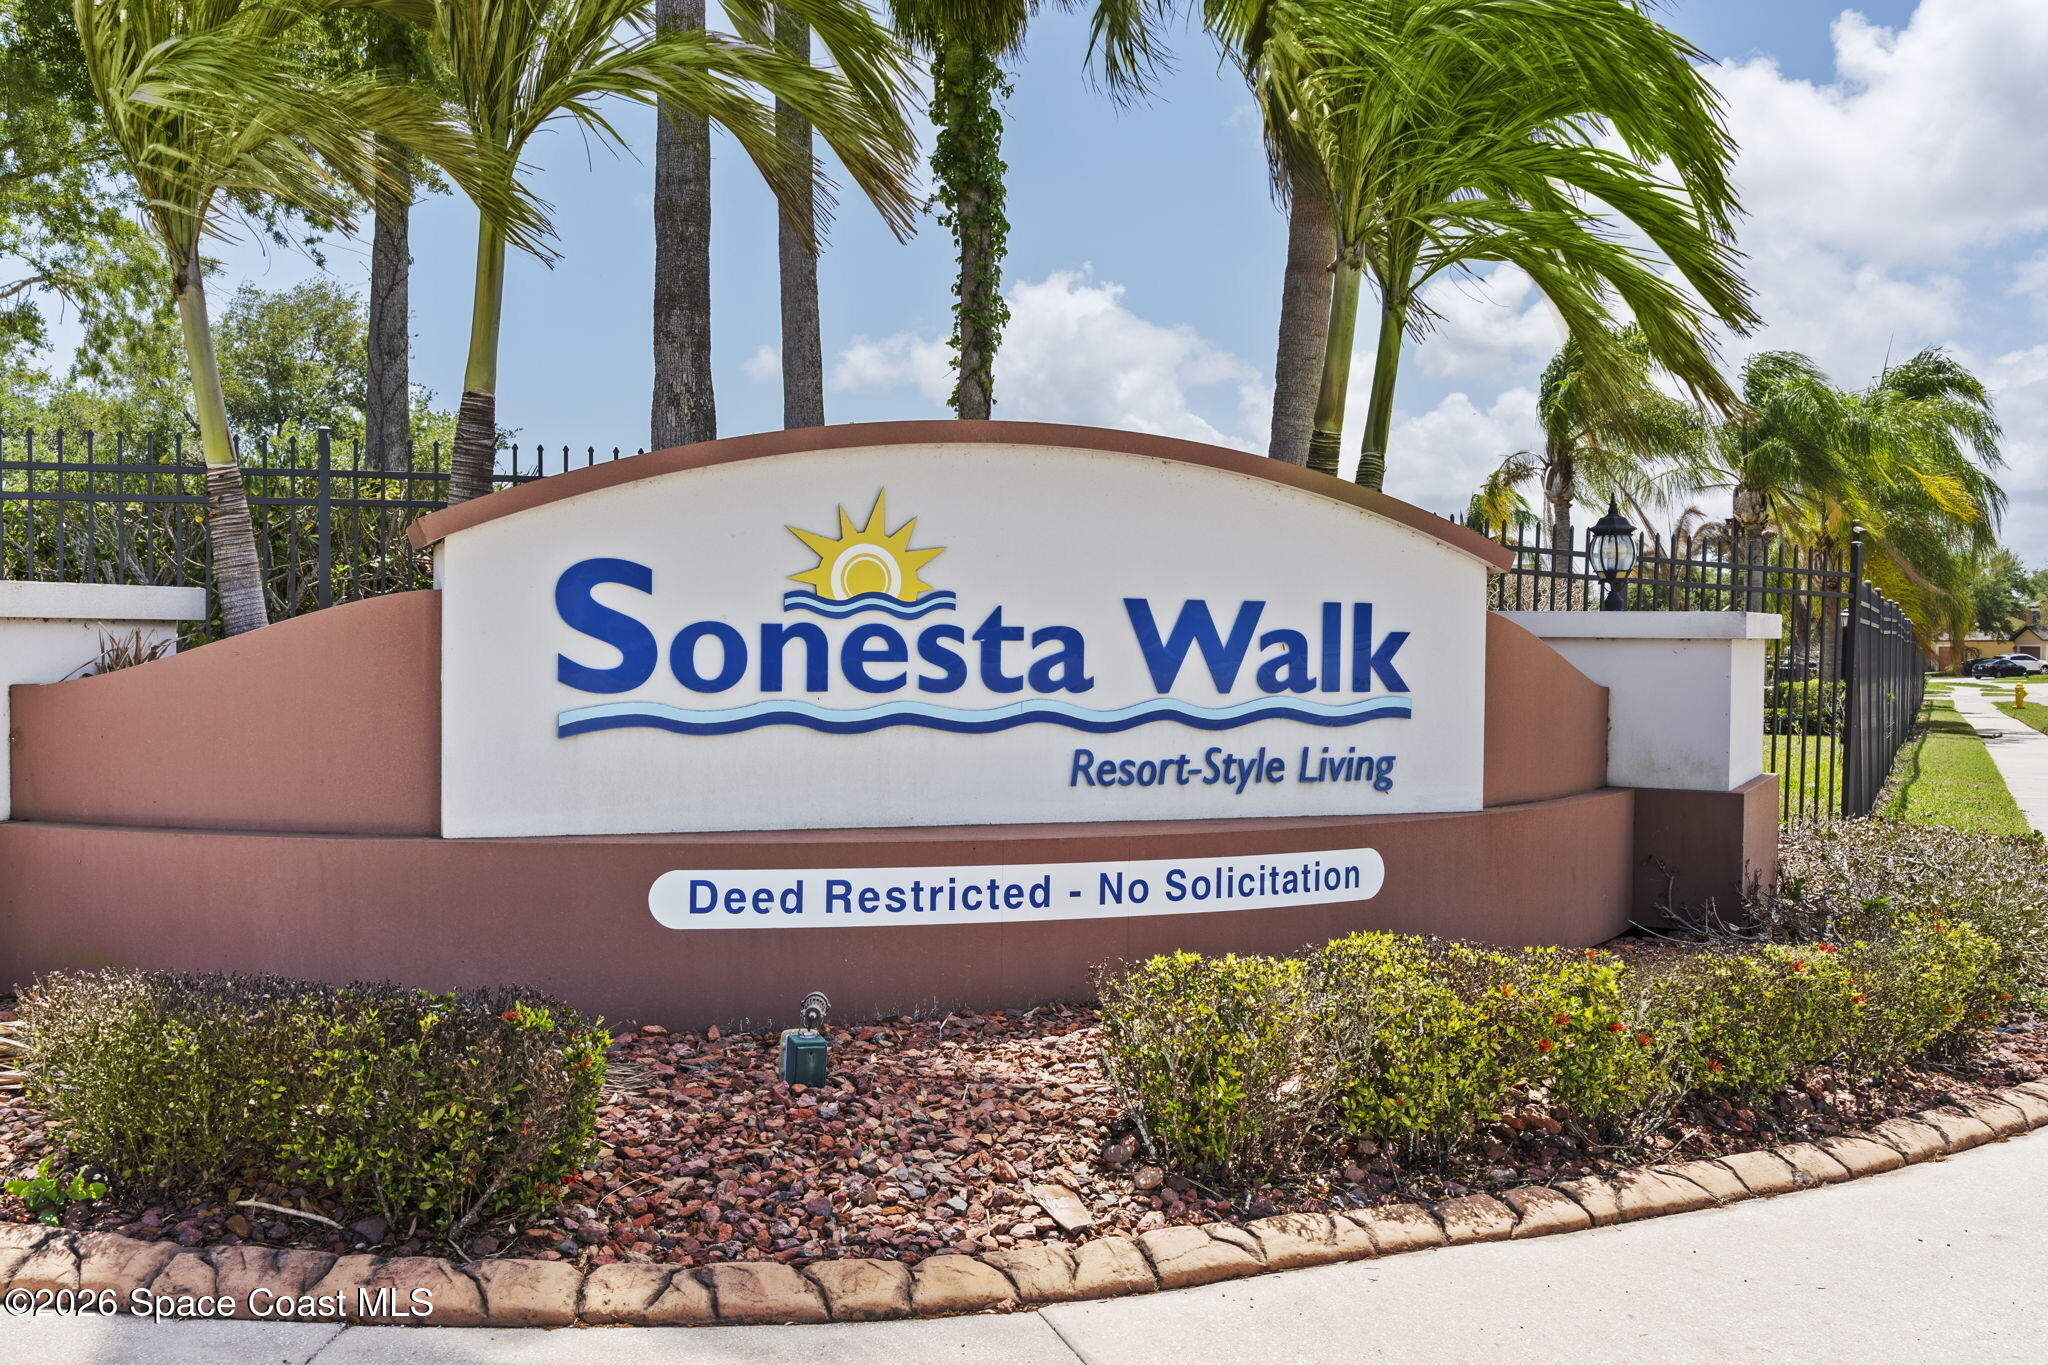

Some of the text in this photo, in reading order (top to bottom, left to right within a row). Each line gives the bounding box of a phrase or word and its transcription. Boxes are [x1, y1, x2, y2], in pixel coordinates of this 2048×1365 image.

[555, 557, 1411, 695] Sonesta Walk
[1070, 746, 1396, 795] Resort-Style Living
[689, 879, 804, 915] Deed
[825, 874, 1051, 914] Restricted
[1099, 871, 1149, 905] No
[1165, 861, 1360, 902] Solicitation
